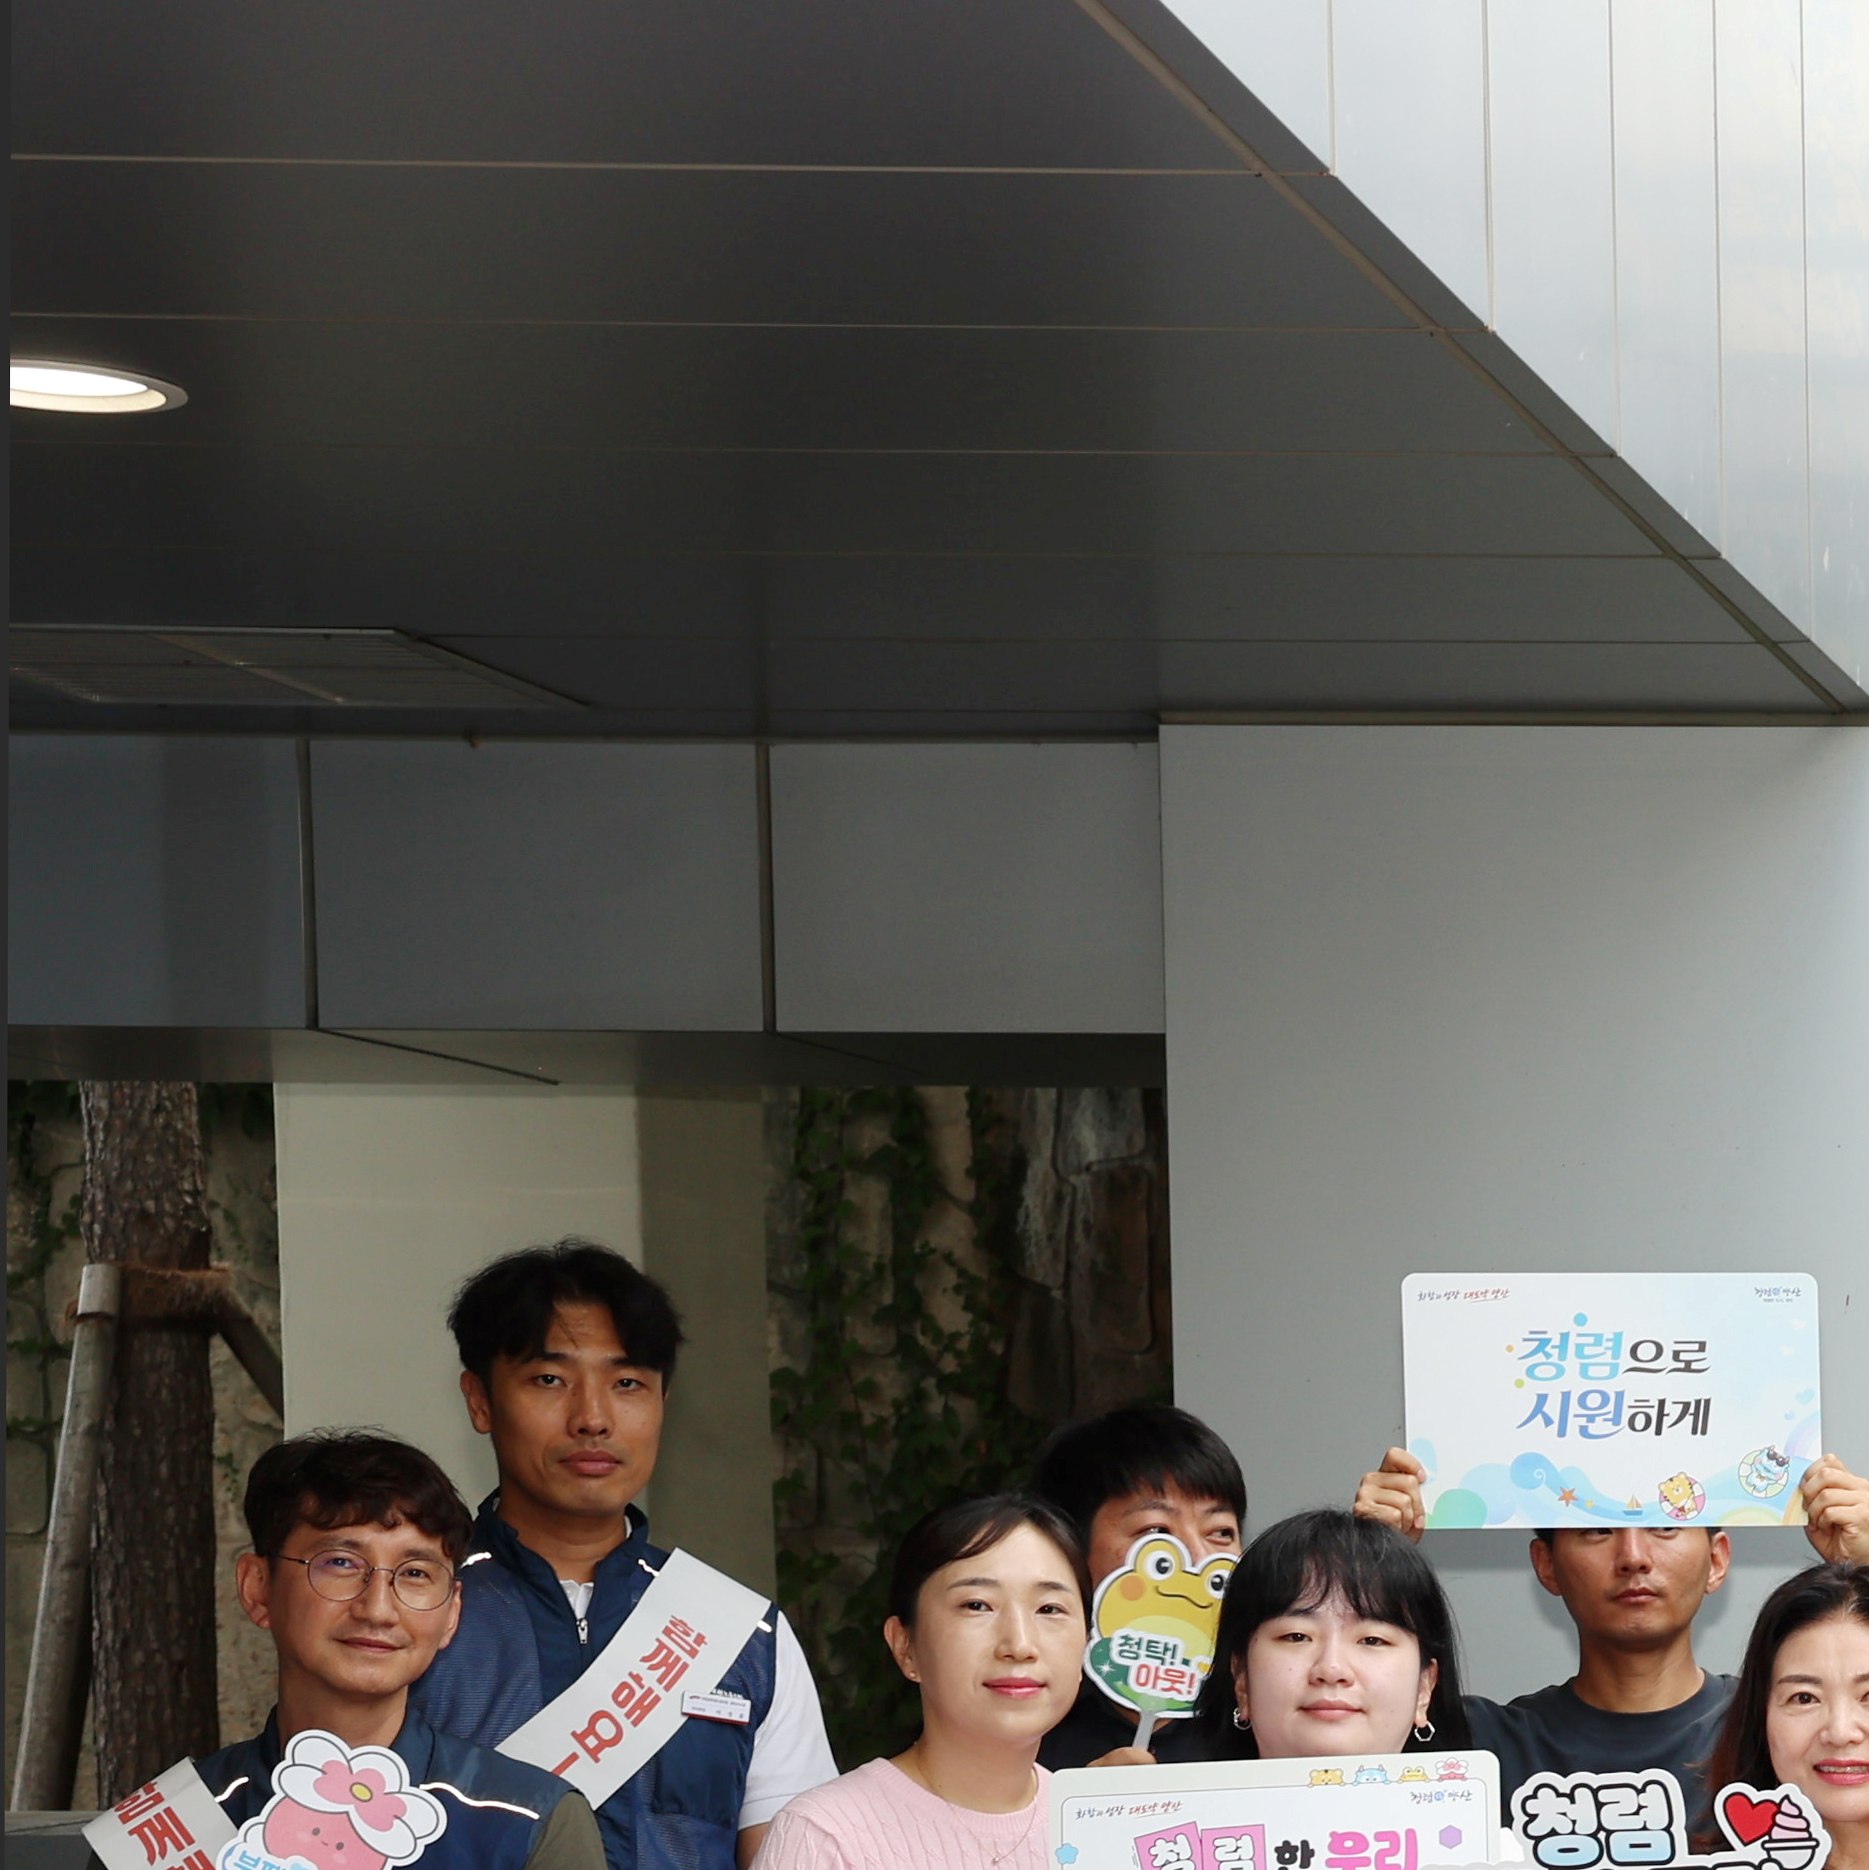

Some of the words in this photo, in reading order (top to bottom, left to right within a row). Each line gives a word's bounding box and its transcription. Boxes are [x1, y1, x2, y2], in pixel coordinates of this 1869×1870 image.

[1518, 1330, 1711, 1382] 청렴으로
[1516, 1389, 1712, 1440] 시원하게
[1118, 1634, 1178, 1665] 청탁!
[1136, 1663, 1195, 1695] 아웃!
[1521, 1780, 1676, 1869] 청렴
